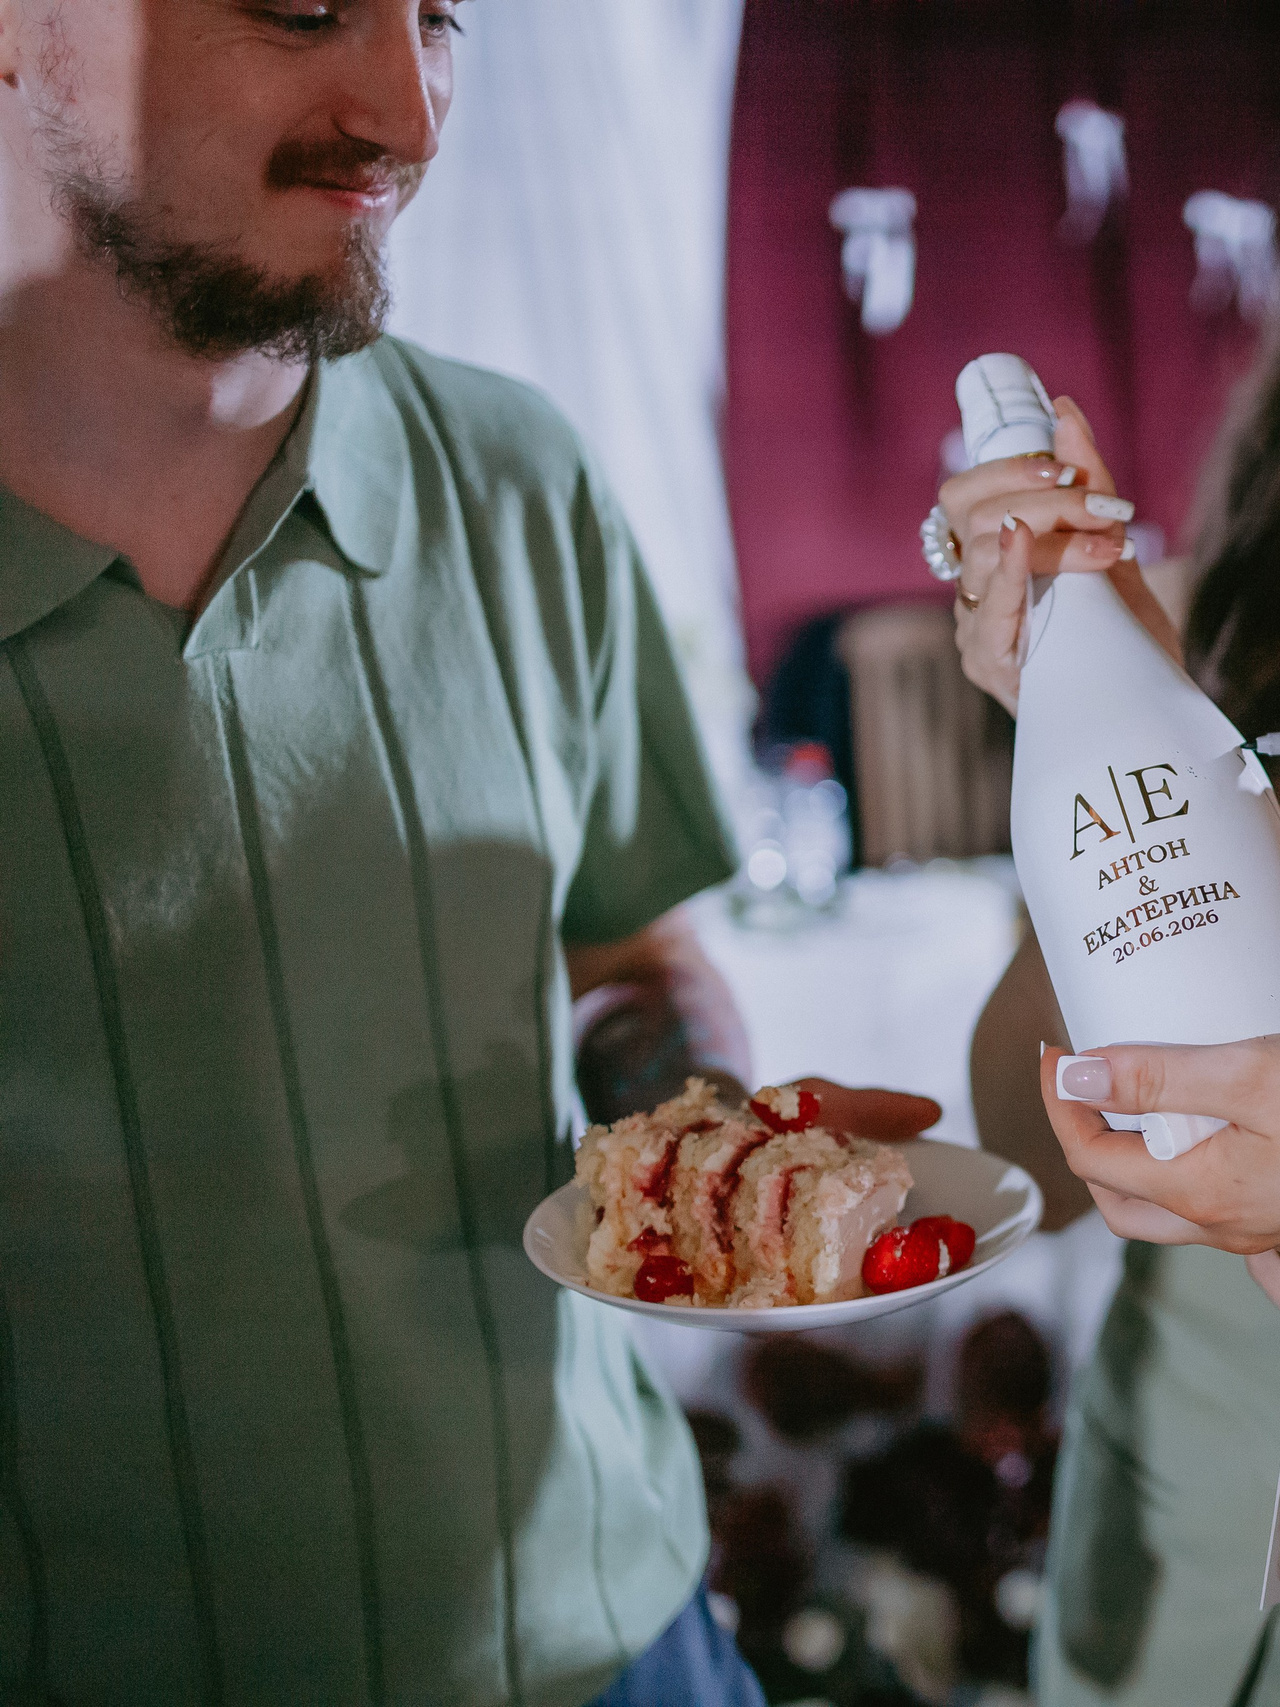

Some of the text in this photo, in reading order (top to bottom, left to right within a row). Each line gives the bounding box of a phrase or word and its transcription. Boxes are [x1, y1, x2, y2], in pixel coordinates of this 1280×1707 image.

[1098, 838, 1191, 890] АНТОН
[1138, 875, 1160, 896] &
[1082, 881, 1241, 956] ЕКАТЕРИНА
[1112, 909, 1219, 964] 20.06.2026
